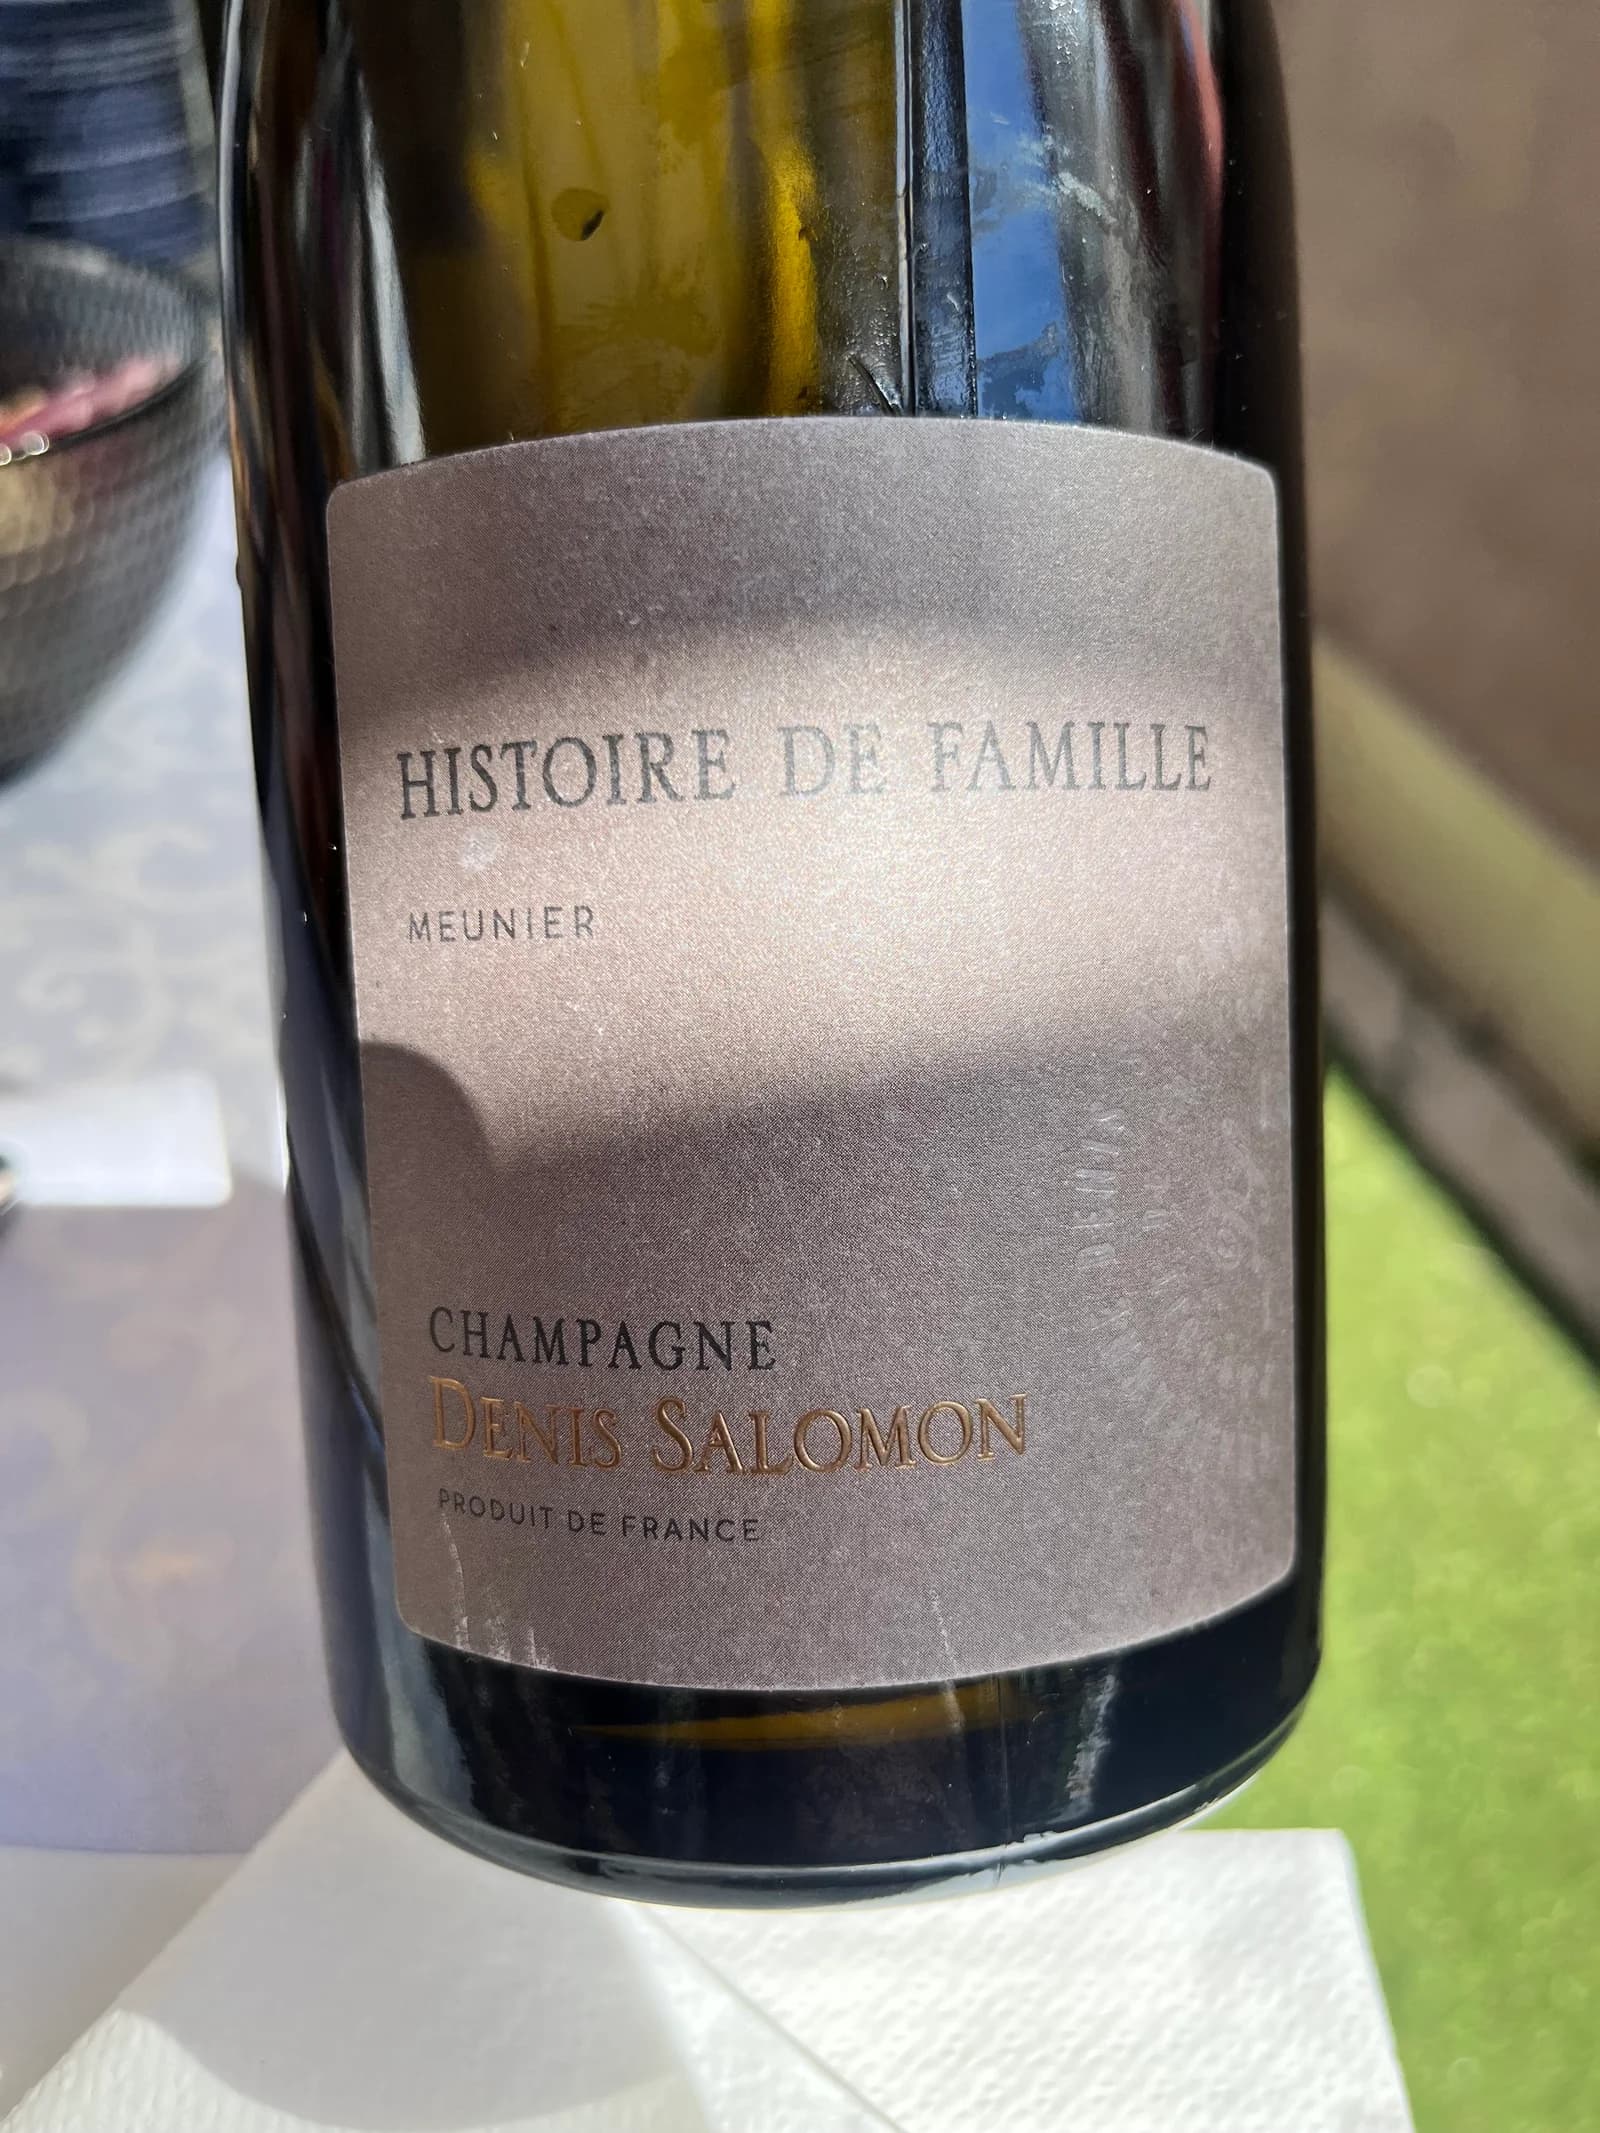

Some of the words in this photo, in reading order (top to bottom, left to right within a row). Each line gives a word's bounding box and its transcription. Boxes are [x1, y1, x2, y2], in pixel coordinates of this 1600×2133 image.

[396, 728, 736, 820] HISTOIRE
[779, 723, 887, 796] DE
[929, 721, 1212, 793] FAMILLE
[407, 905, 597, 943] MEUNIER
[429, 1306, 776, 1372] CHAMPAGNE
[440, 1489, 553, 1529] PRODUIT
[568, 1510, 608, 1537] DE
[620, 1514, 760, 1543] FRANCE
